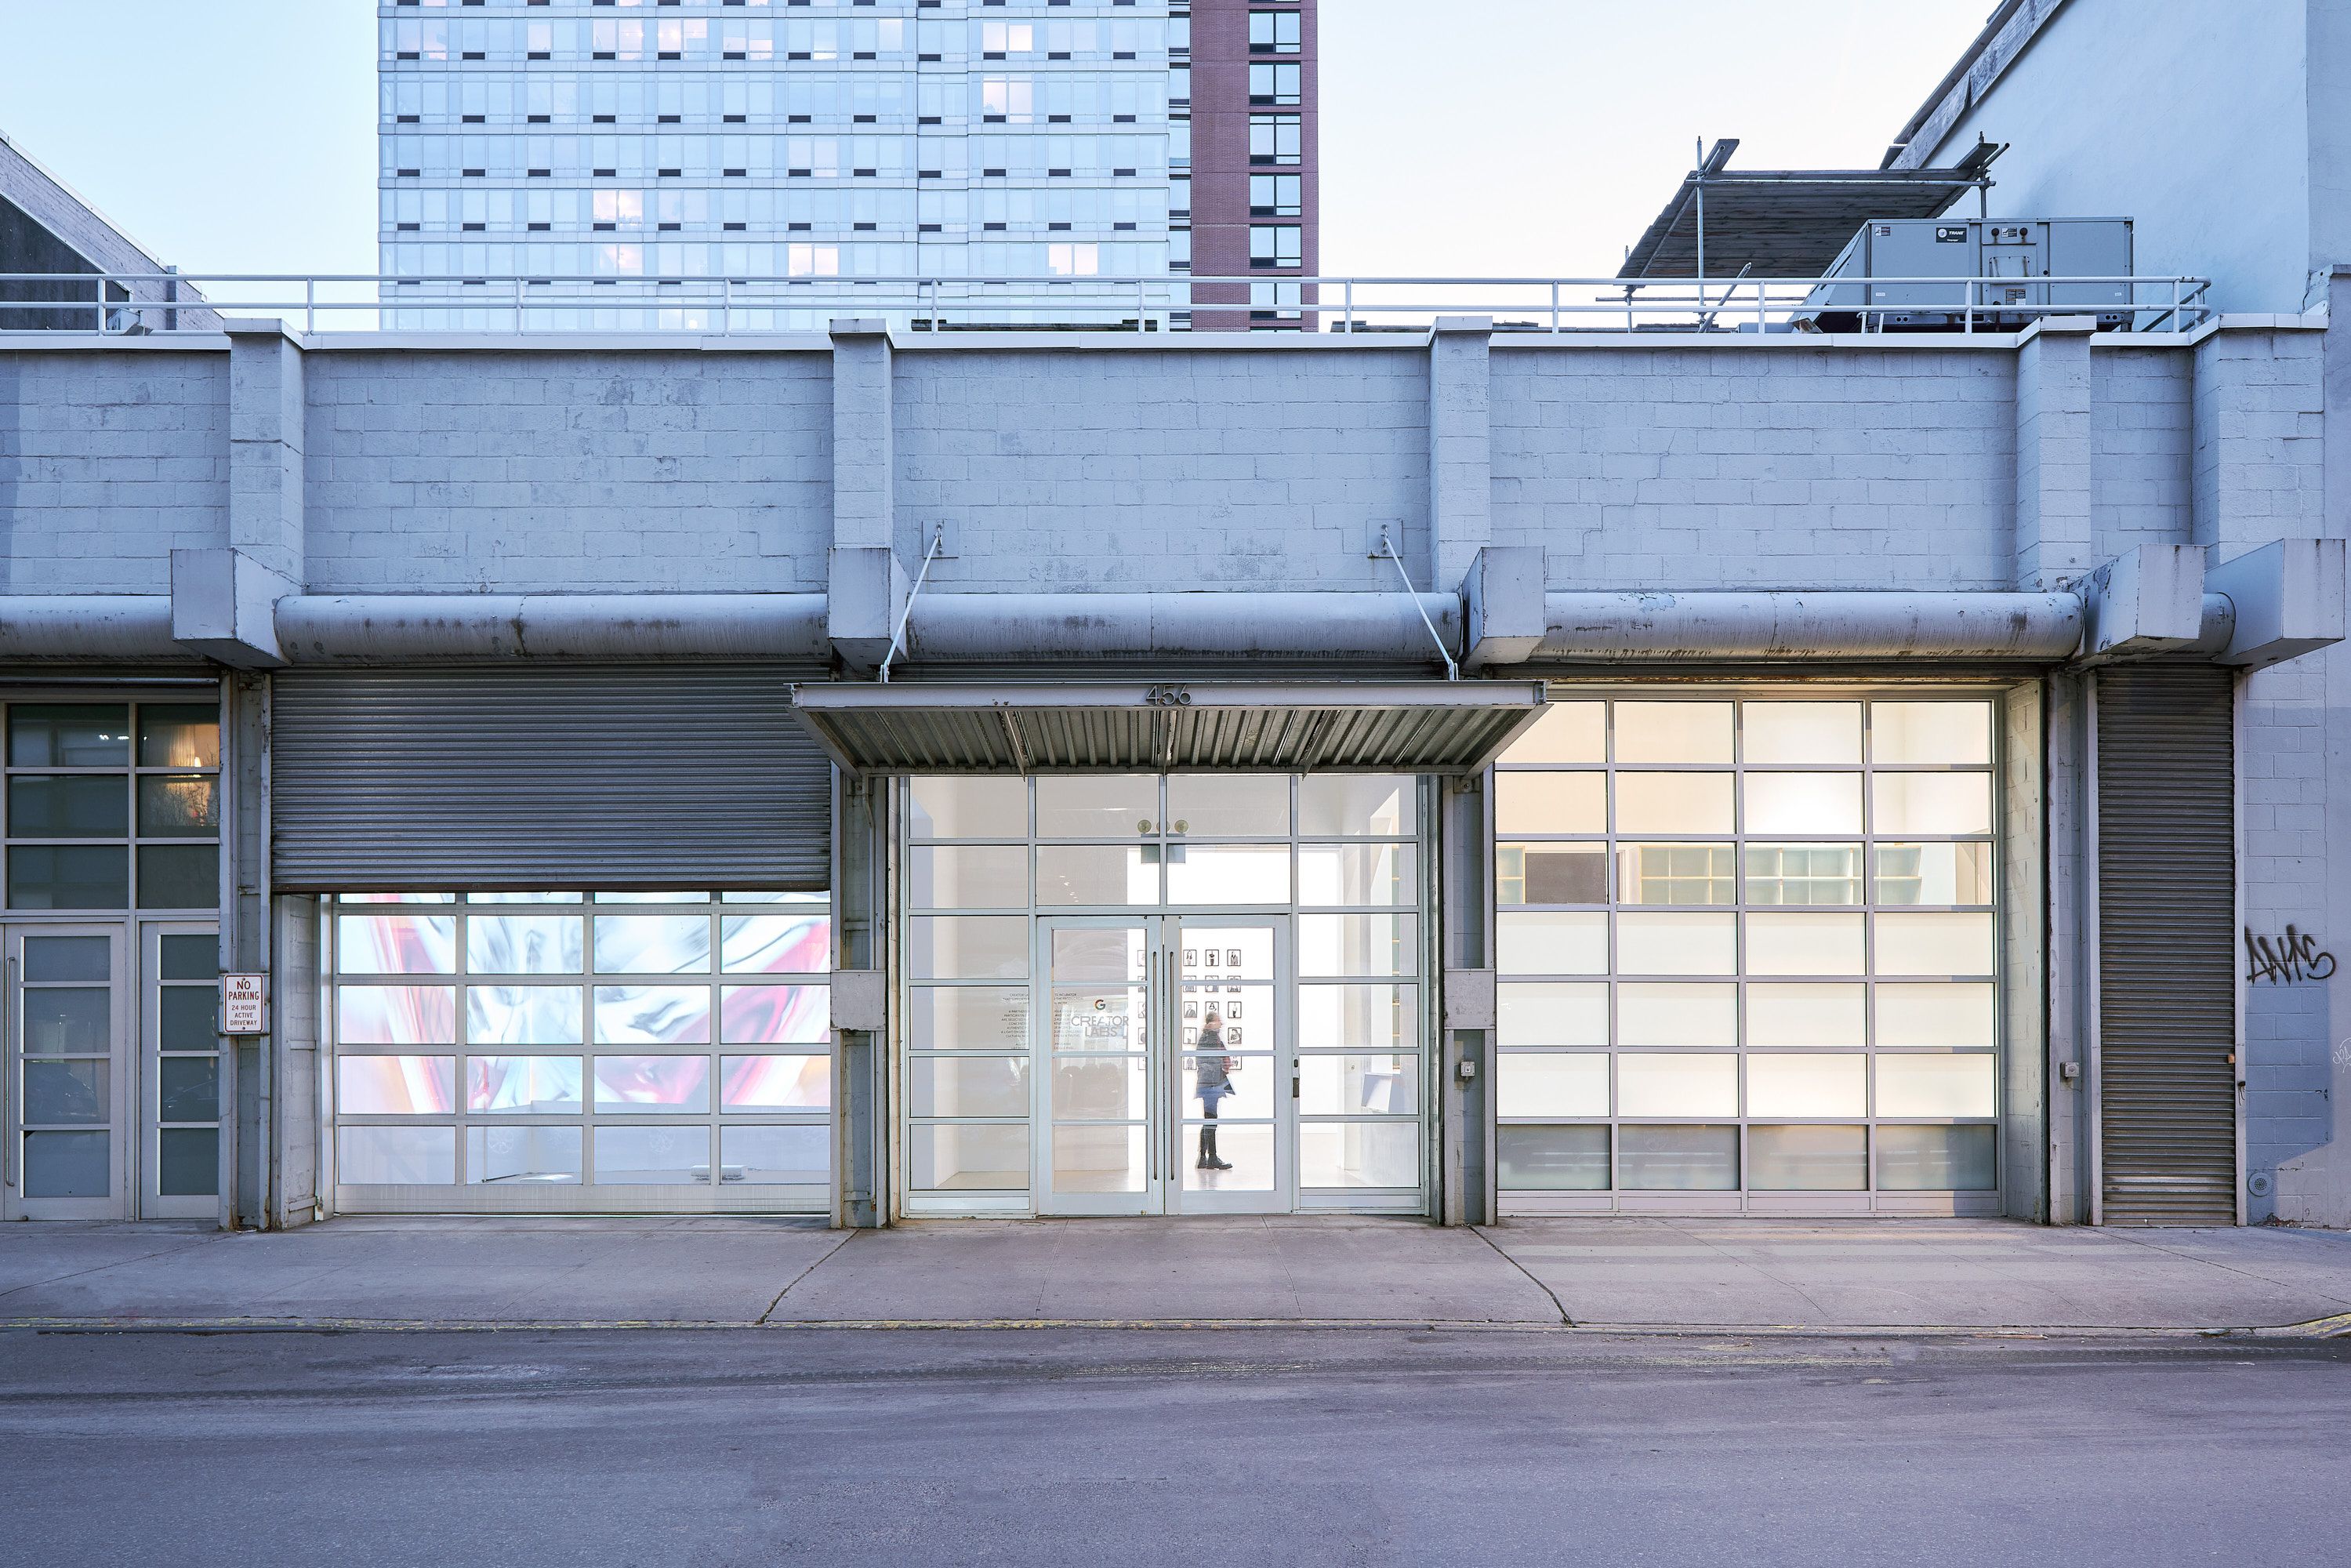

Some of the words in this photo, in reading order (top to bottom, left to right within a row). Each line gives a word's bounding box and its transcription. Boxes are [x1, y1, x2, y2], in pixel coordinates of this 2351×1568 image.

[1146, 684, 1192, 705] 456
[237, 981, 251, 989] NO
[228, 991, 259, 1000] PARKING
[1095, 1000, 1106, 1010] G
[1071, 1015, 1129, 1026] CREATOR
[1085, 1027, 1117, 1037] LABS
